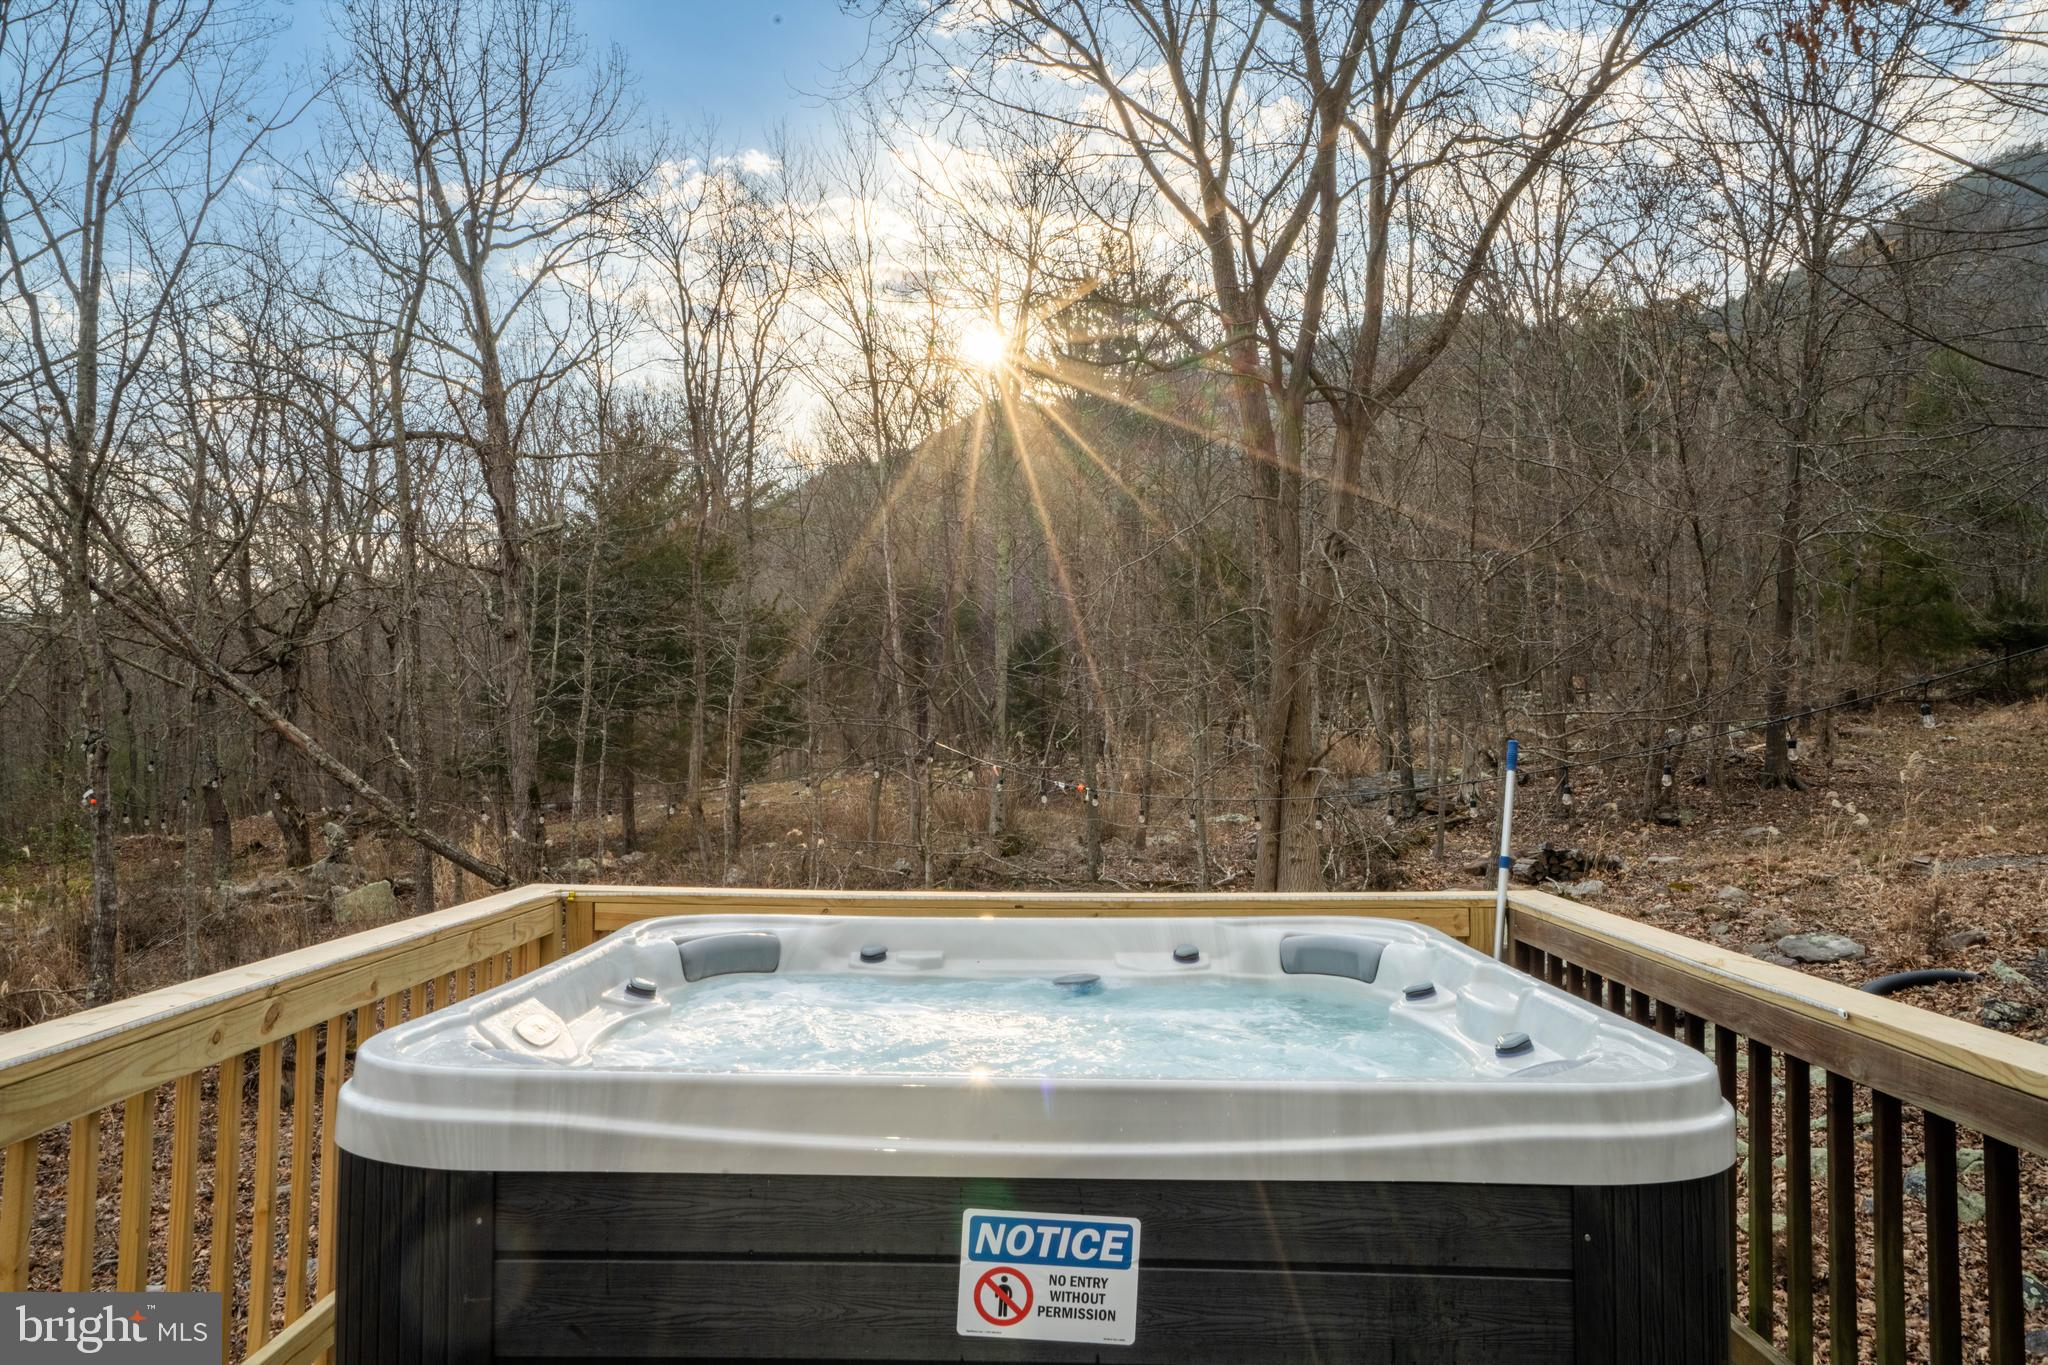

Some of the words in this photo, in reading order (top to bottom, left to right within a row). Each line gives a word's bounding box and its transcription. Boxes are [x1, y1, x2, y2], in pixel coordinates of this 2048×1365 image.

[975, 1222, 1128, 1262] NOTICE
[1049, 1274, 1066, 1287] NO
[1070, 1275, 1109, 1289] ENTRY
[1050, 1290, 1106, 1305] WITHOUT
[1037, 1305, 1116, 1322] PERMISSION
